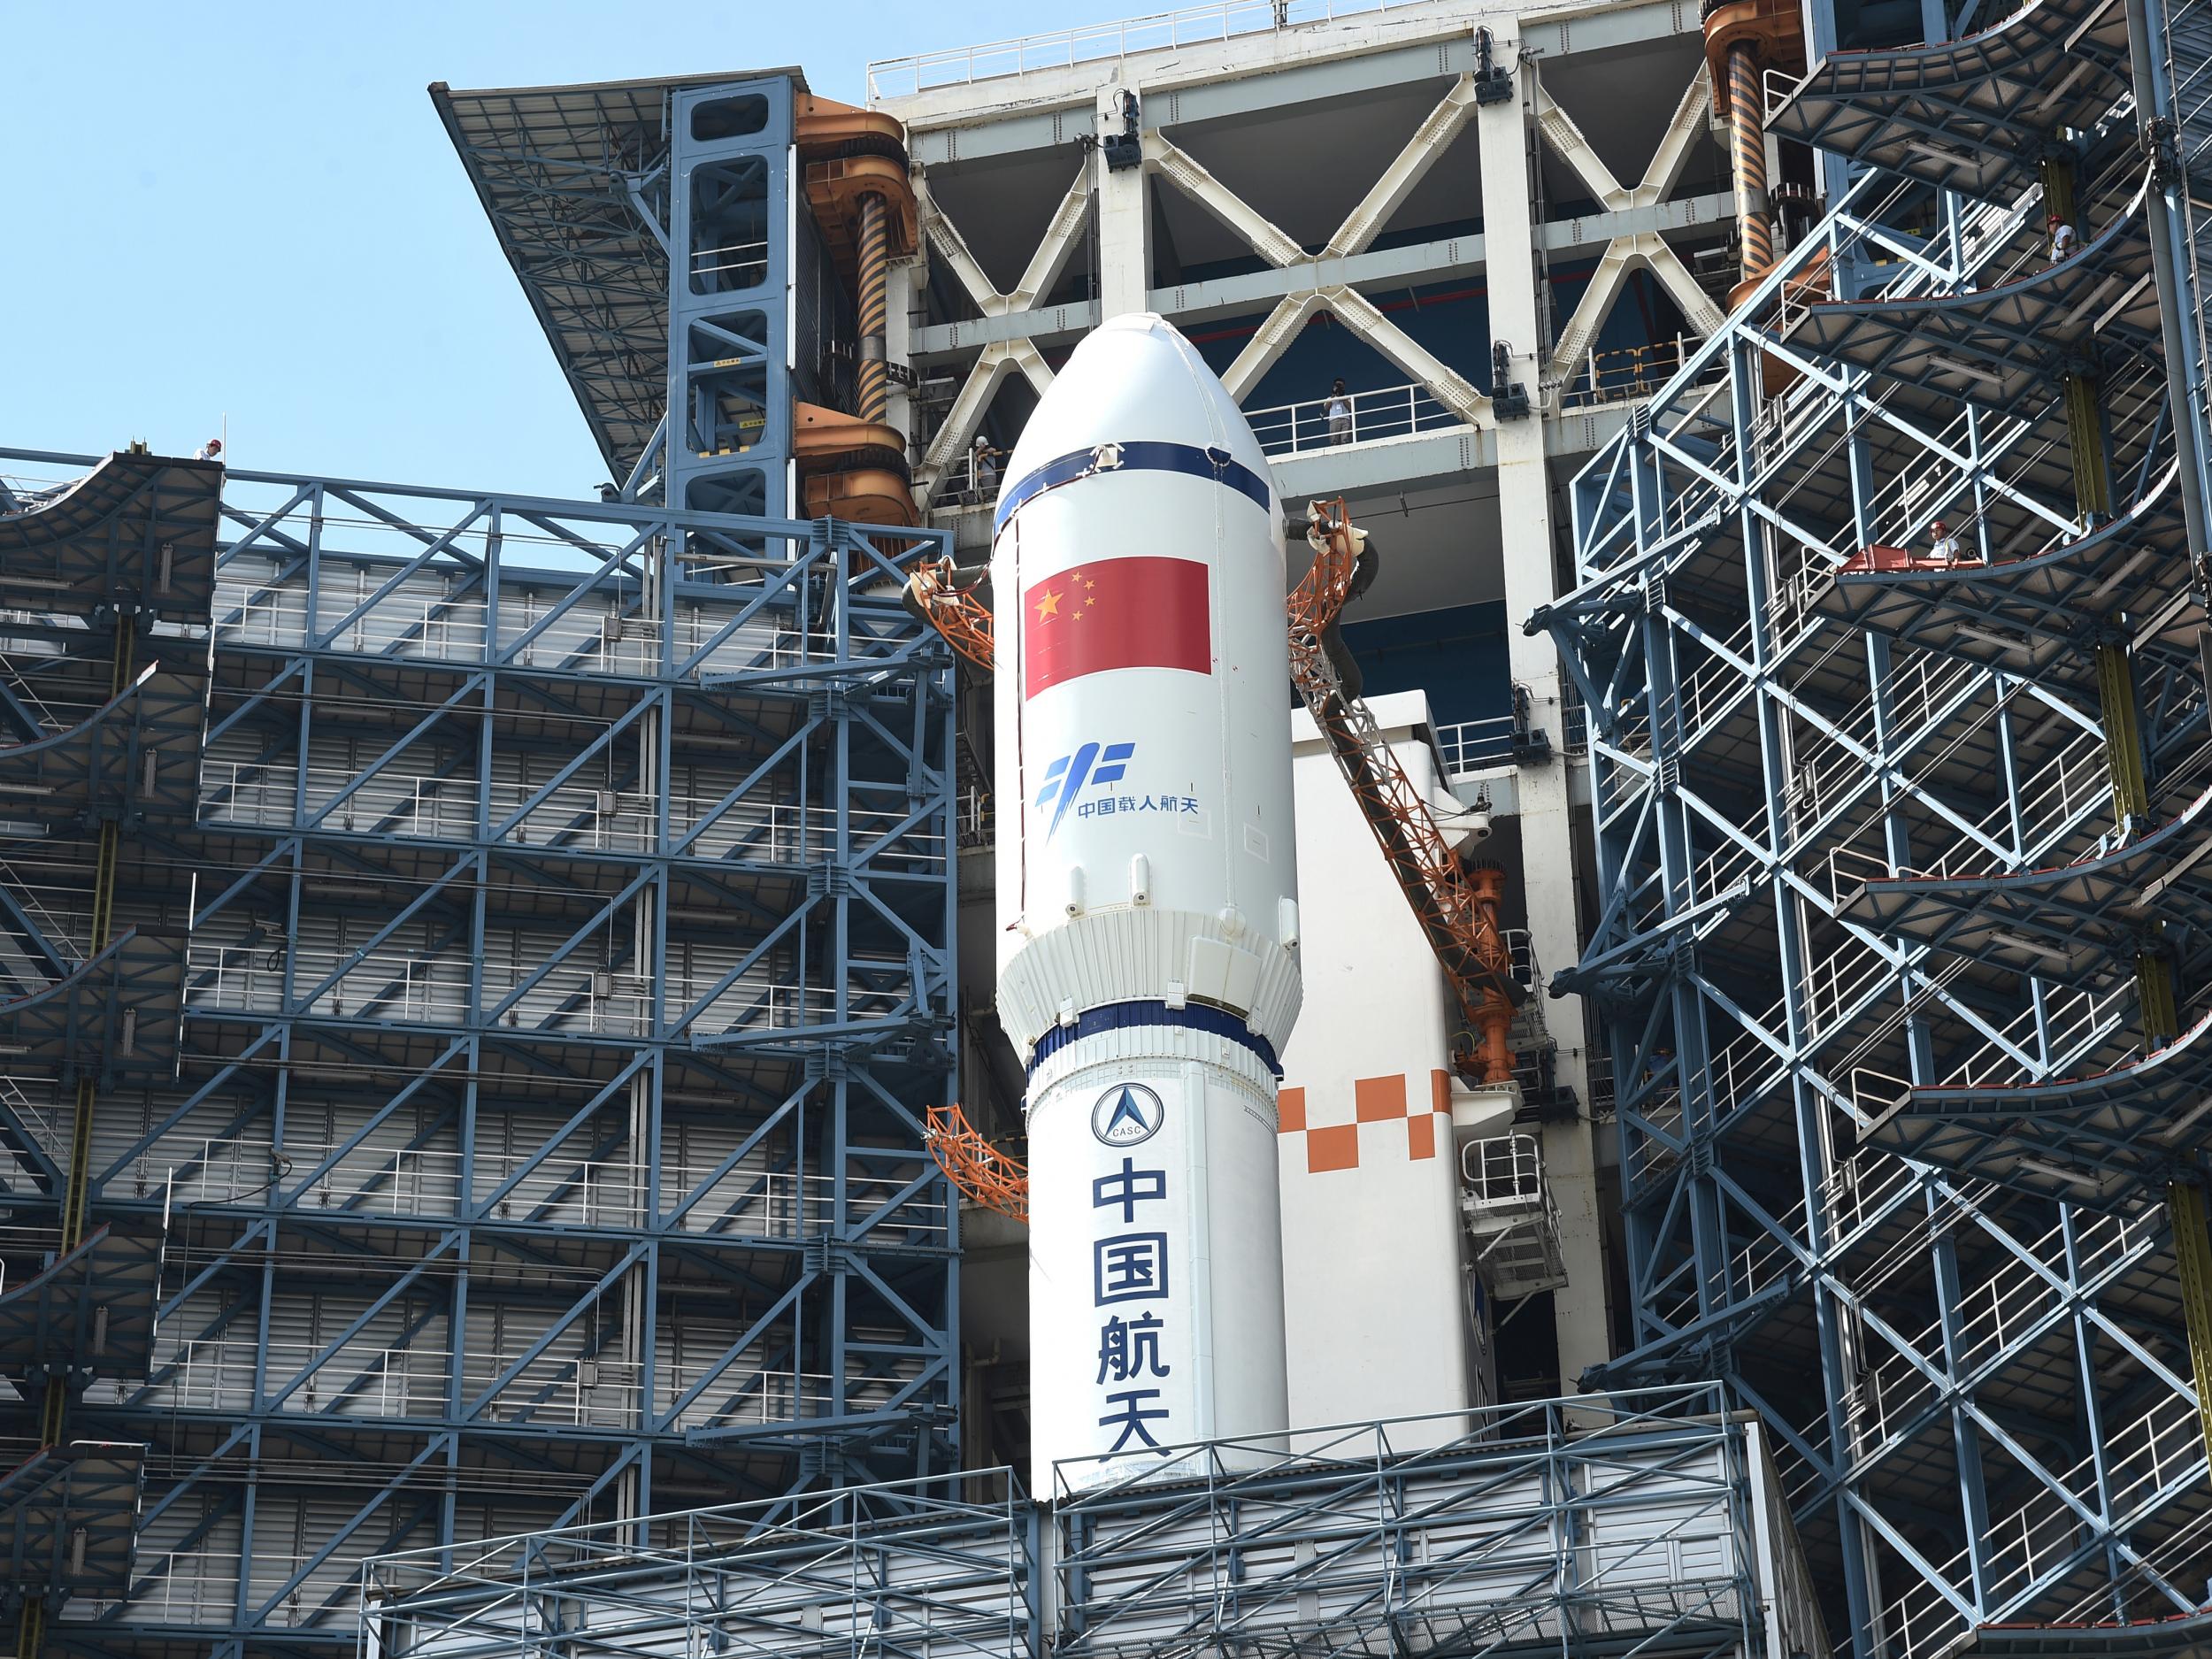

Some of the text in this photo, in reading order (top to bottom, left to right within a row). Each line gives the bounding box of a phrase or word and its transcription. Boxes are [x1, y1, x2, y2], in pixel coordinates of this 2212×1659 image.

[1078, 795, 1198, 818] 中国载人航天
[1112, 1125, 1141, 1137] CASC
[1093, 1156, 1171, 1463] 中国航天
